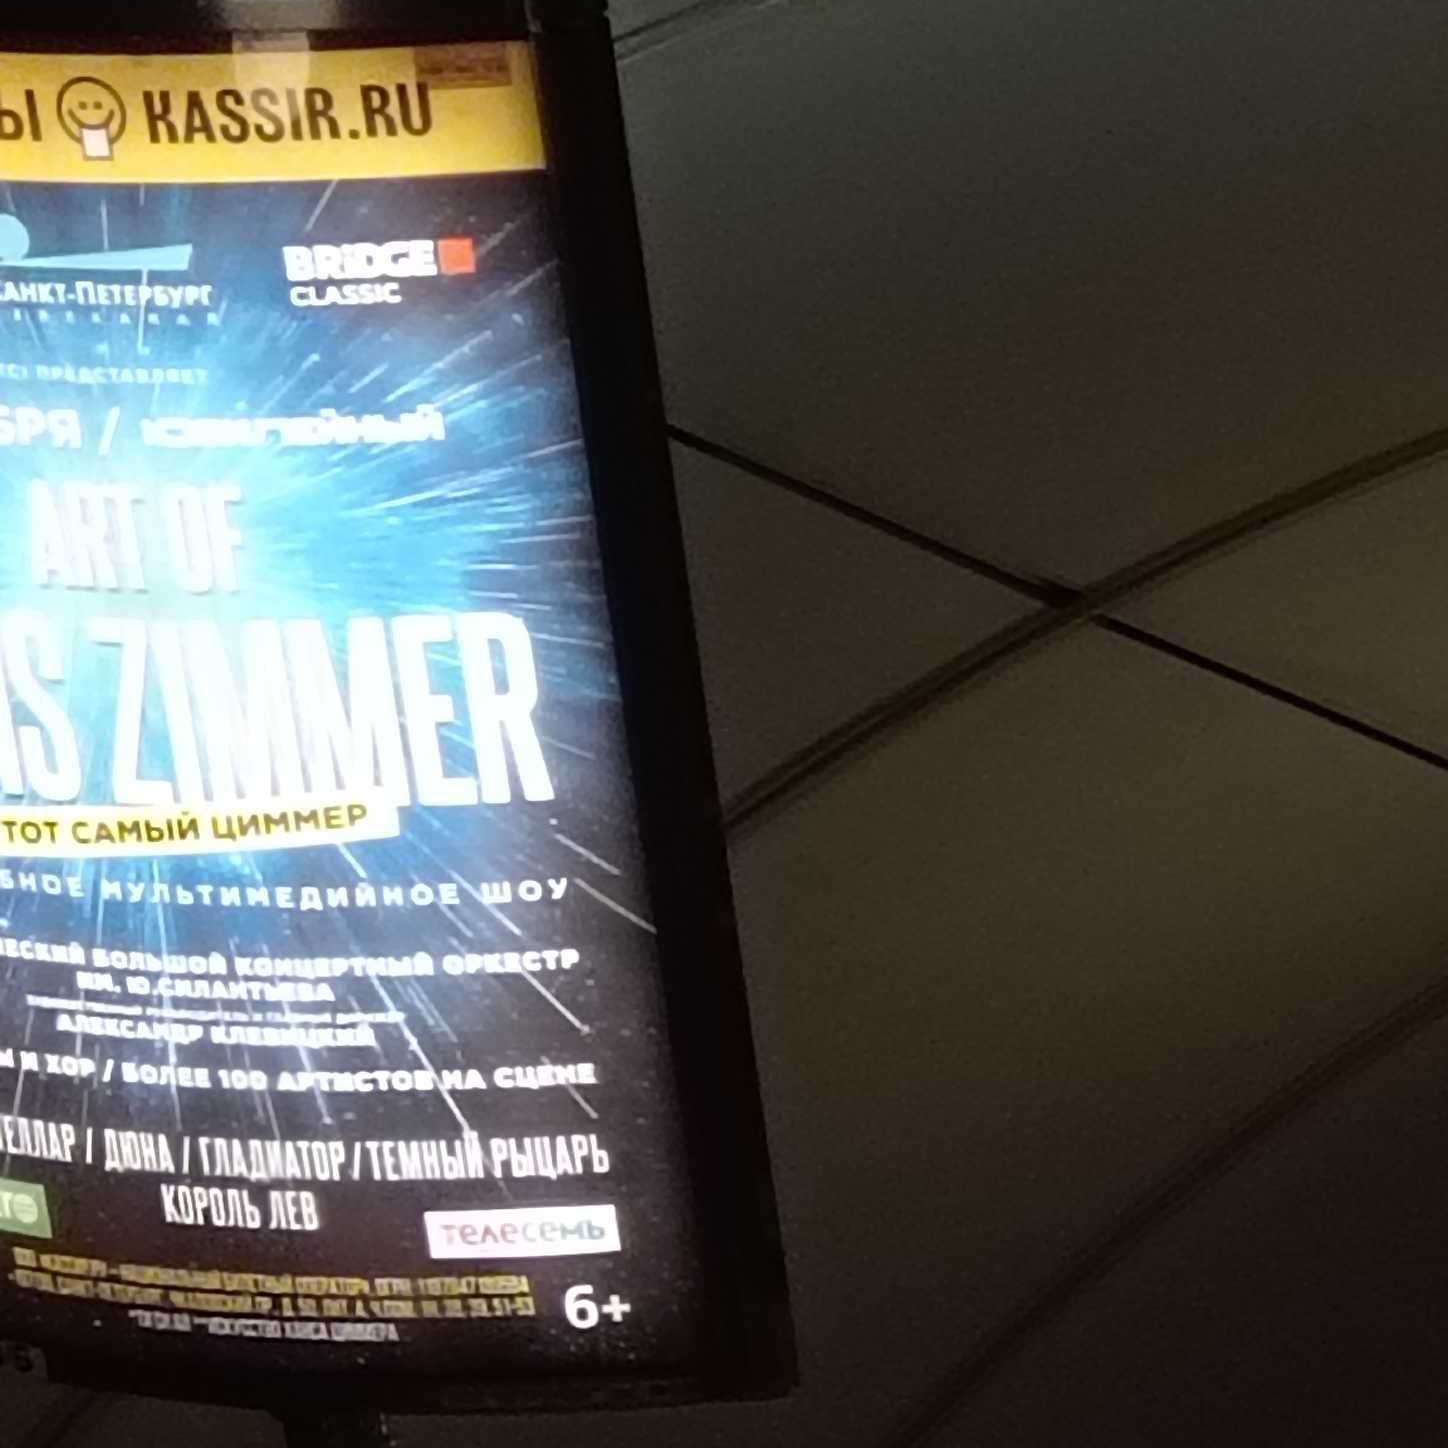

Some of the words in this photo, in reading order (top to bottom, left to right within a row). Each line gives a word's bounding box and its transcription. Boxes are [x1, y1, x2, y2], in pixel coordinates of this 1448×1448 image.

[142, 81, 434, 145] KASSIR.RU
[290, 283, 402, 307] CLASSIC
[29, 478, 145, 593] ART
[160, 482, 243, 595] OF
[88, 611, 556, 807] ZIMMER
[72, 811, 200, 845] САМЫЙ
[212, 803, 368, 842] ЦИММЕР
[102, 876, 460, 911] МУЛЬТИМЕДИЙНОЕ
[481, 876, 571, 906] ШОУ
[0, 937, 86, 966] ЕСКИЙ
[92, 947, 228, 976] БОЛЬШОЙ
[234, 951, 435, 980] КОНЦЕРТНЫЙ
[442, 948, 580, 975] ОРКЕСТР
[44, 1053, 96, 1078] ХОР
[122, 1061, 212, 1089] БОЛЕЕ
[217, 1068, 268, 1091] 100
[277, 1069, 438, 1093] АРТИСТОВ
[441, 1068, 487, 1091] НА
[493, 1062, 599, 1090] СЦЕНЕ
[0, 1113, 76, 1163] ЕЛЛАР
[103, 1127, 175, 1174] ДЮНА
[198, 1135, 346, 1183] ГЛАДИАТОР
[365, 1130, 485, 1181] ТЕМНЫЙ
[490, 1133, 610, 1181] РЫЦАРЬ
[160, 1182, 262, 1230] КОРОЛЬ
[269, 1189, 320, 1232] ЛЕВ
[564, 1283, 632, 1329] 6+
